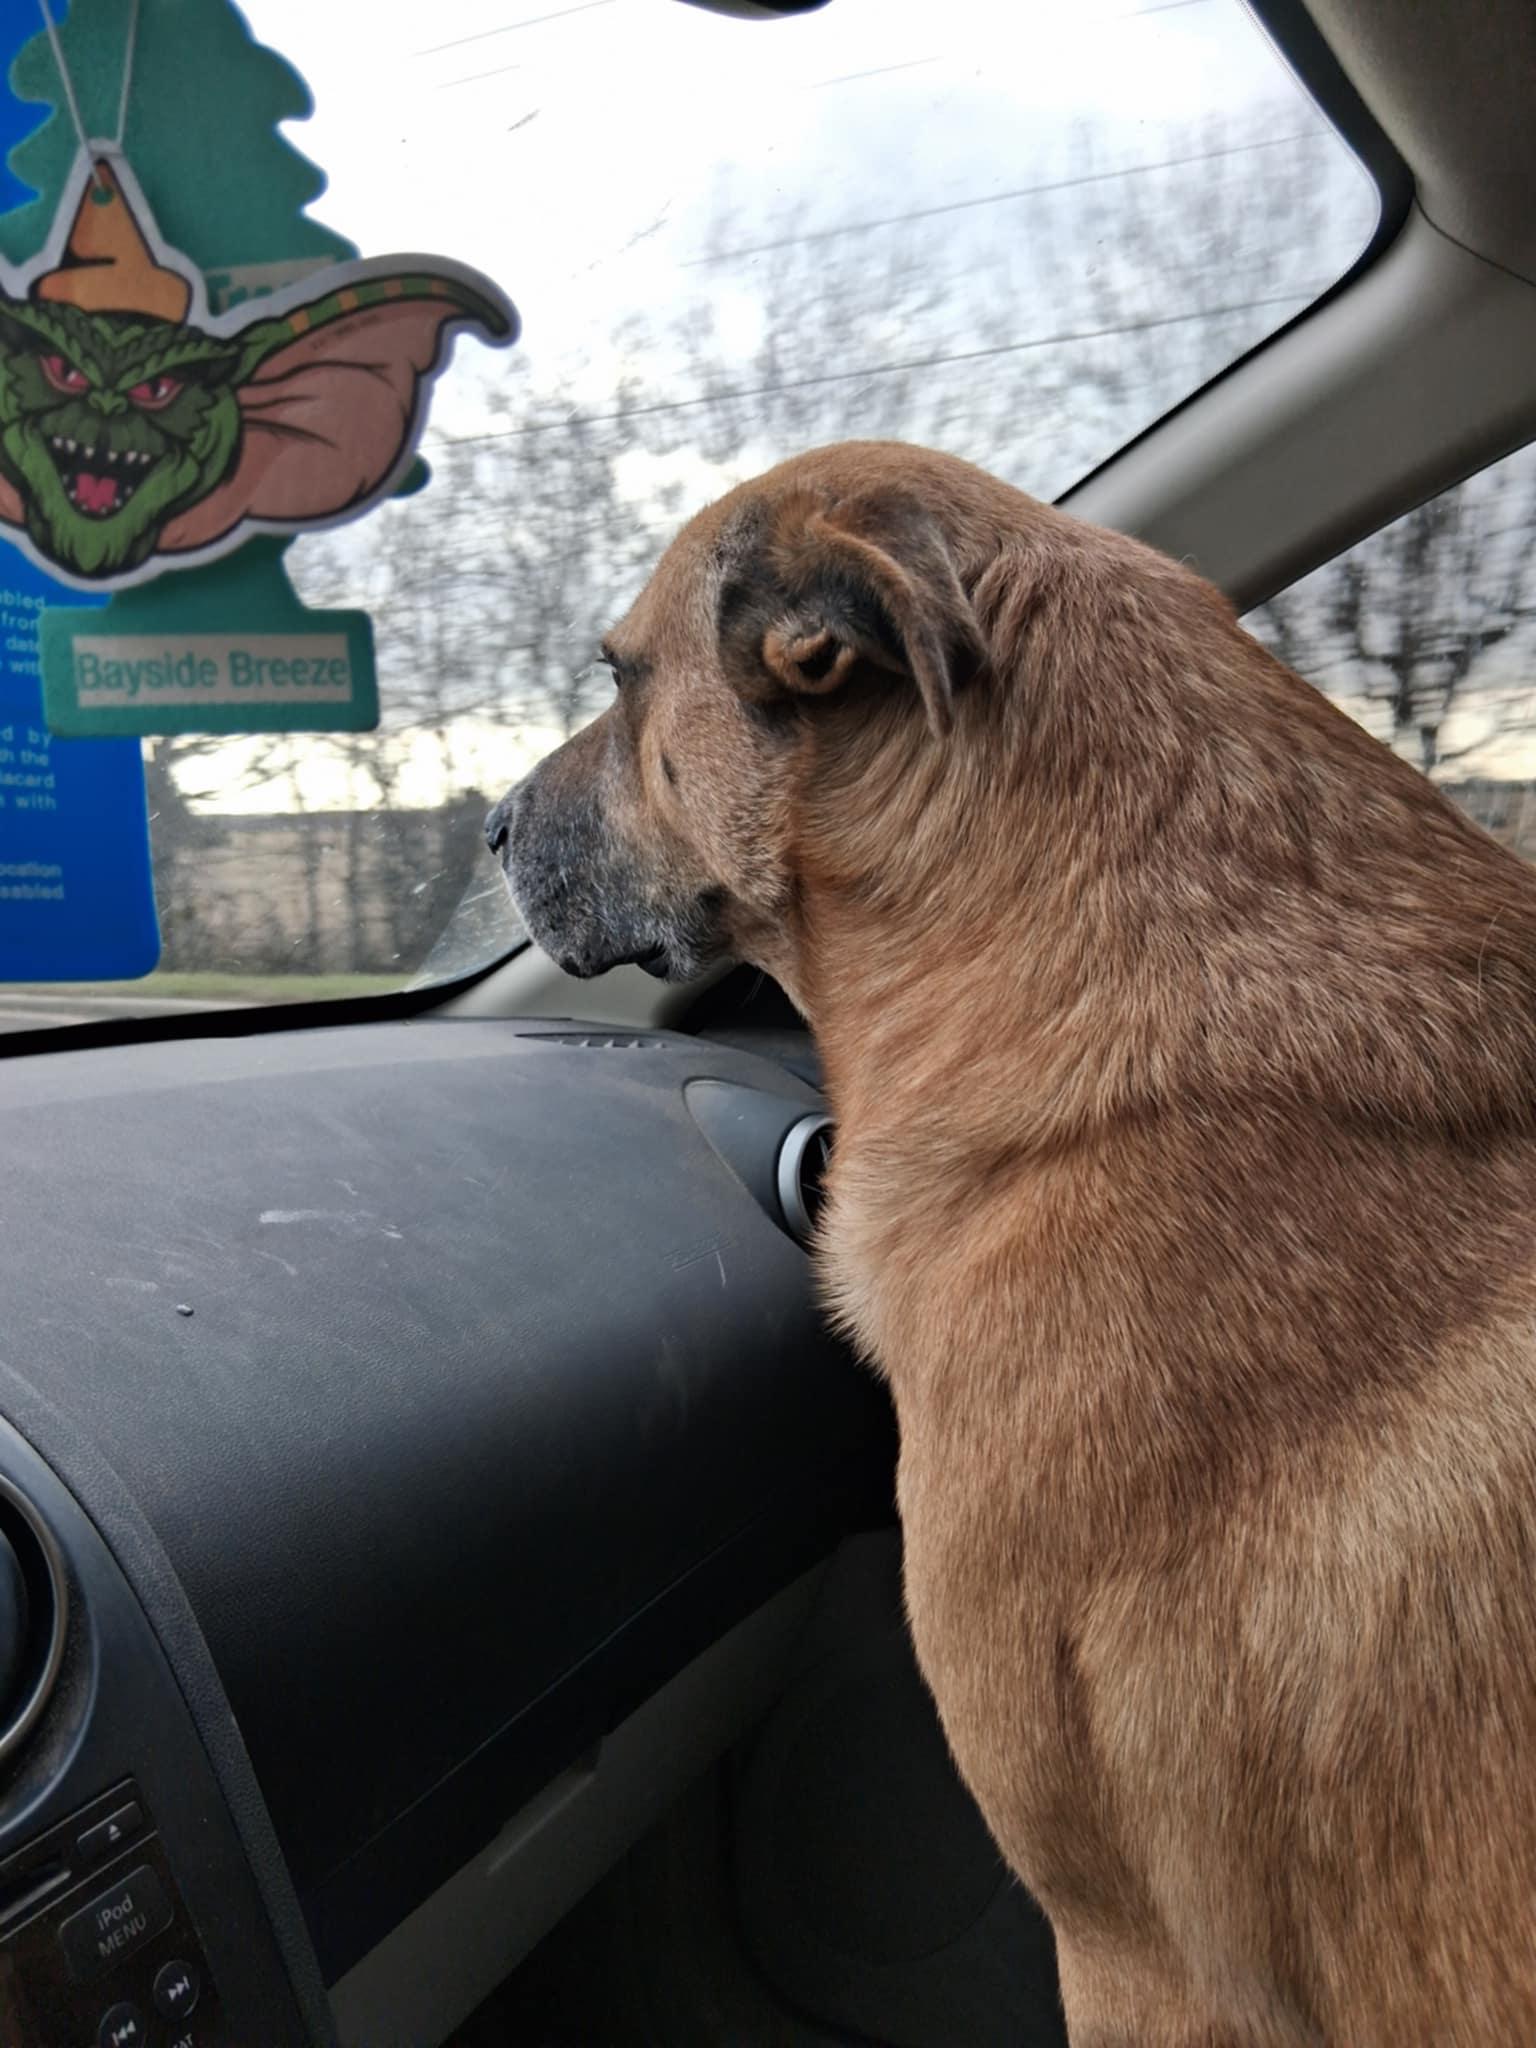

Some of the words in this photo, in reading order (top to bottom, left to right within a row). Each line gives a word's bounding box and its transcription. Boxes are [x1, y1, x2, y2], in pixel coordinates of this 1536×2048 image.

[78, 650, 219, 696] Bayside
[228, 650, 348, 688] Breeze
[26, 726, 53, 749] by
[20, 748, 49, 767] the
[14, 791, 57, 810] with
[96, 1892, 134, 1931] iPod
[98, 1912, 146, 1958] MENU
[172, 2032, 193, 2048] AT
